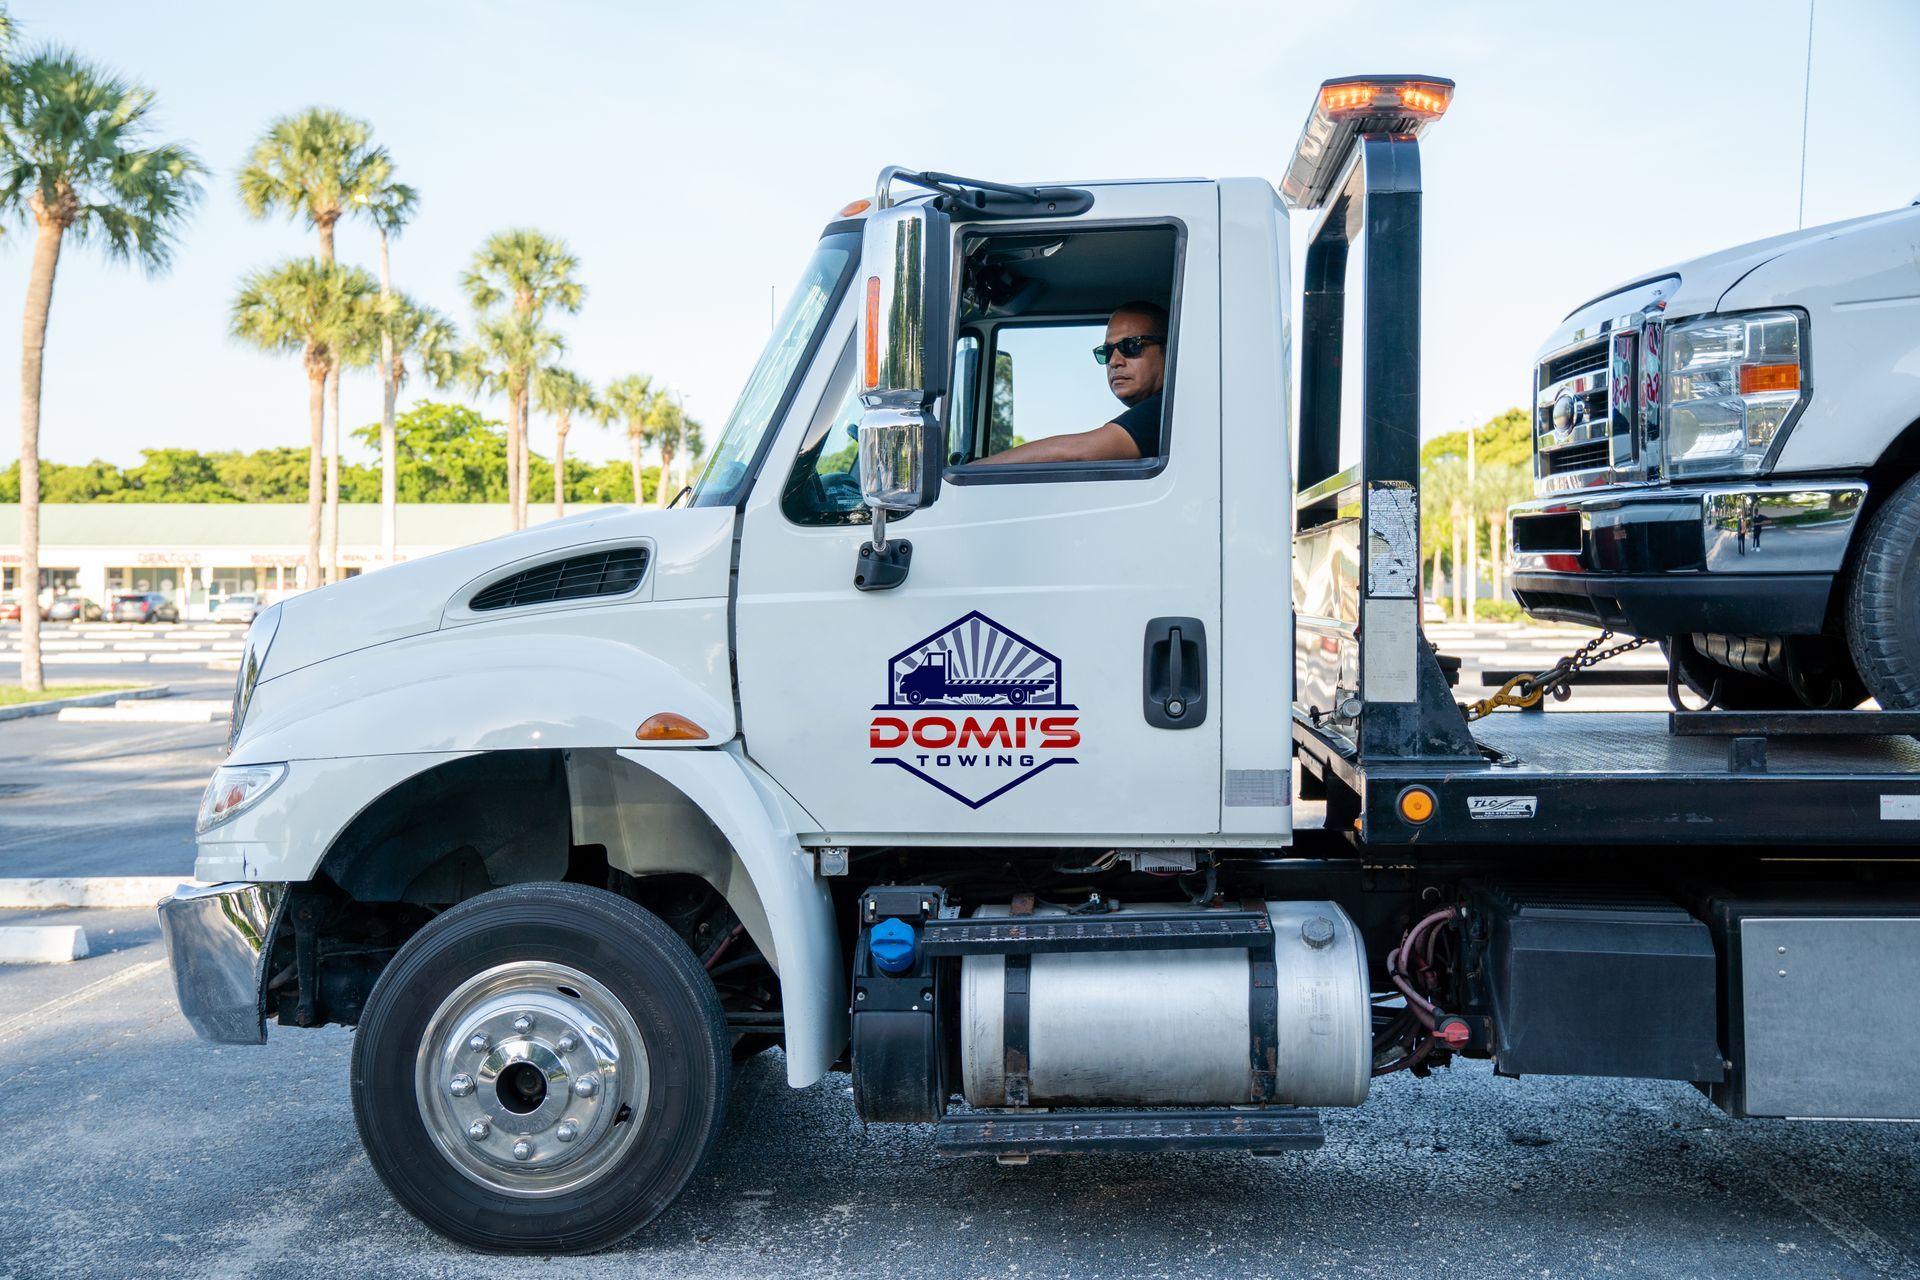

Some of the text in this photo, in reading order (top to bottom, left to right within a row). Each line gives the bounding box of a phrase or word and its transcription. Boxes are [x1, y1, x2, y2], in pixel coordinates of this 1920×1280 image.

[870, 716, 1081, 748] DOMI'S
[916, 755, 1034, 767] TOWING
[1474, 799, 1498, 807] TLC
